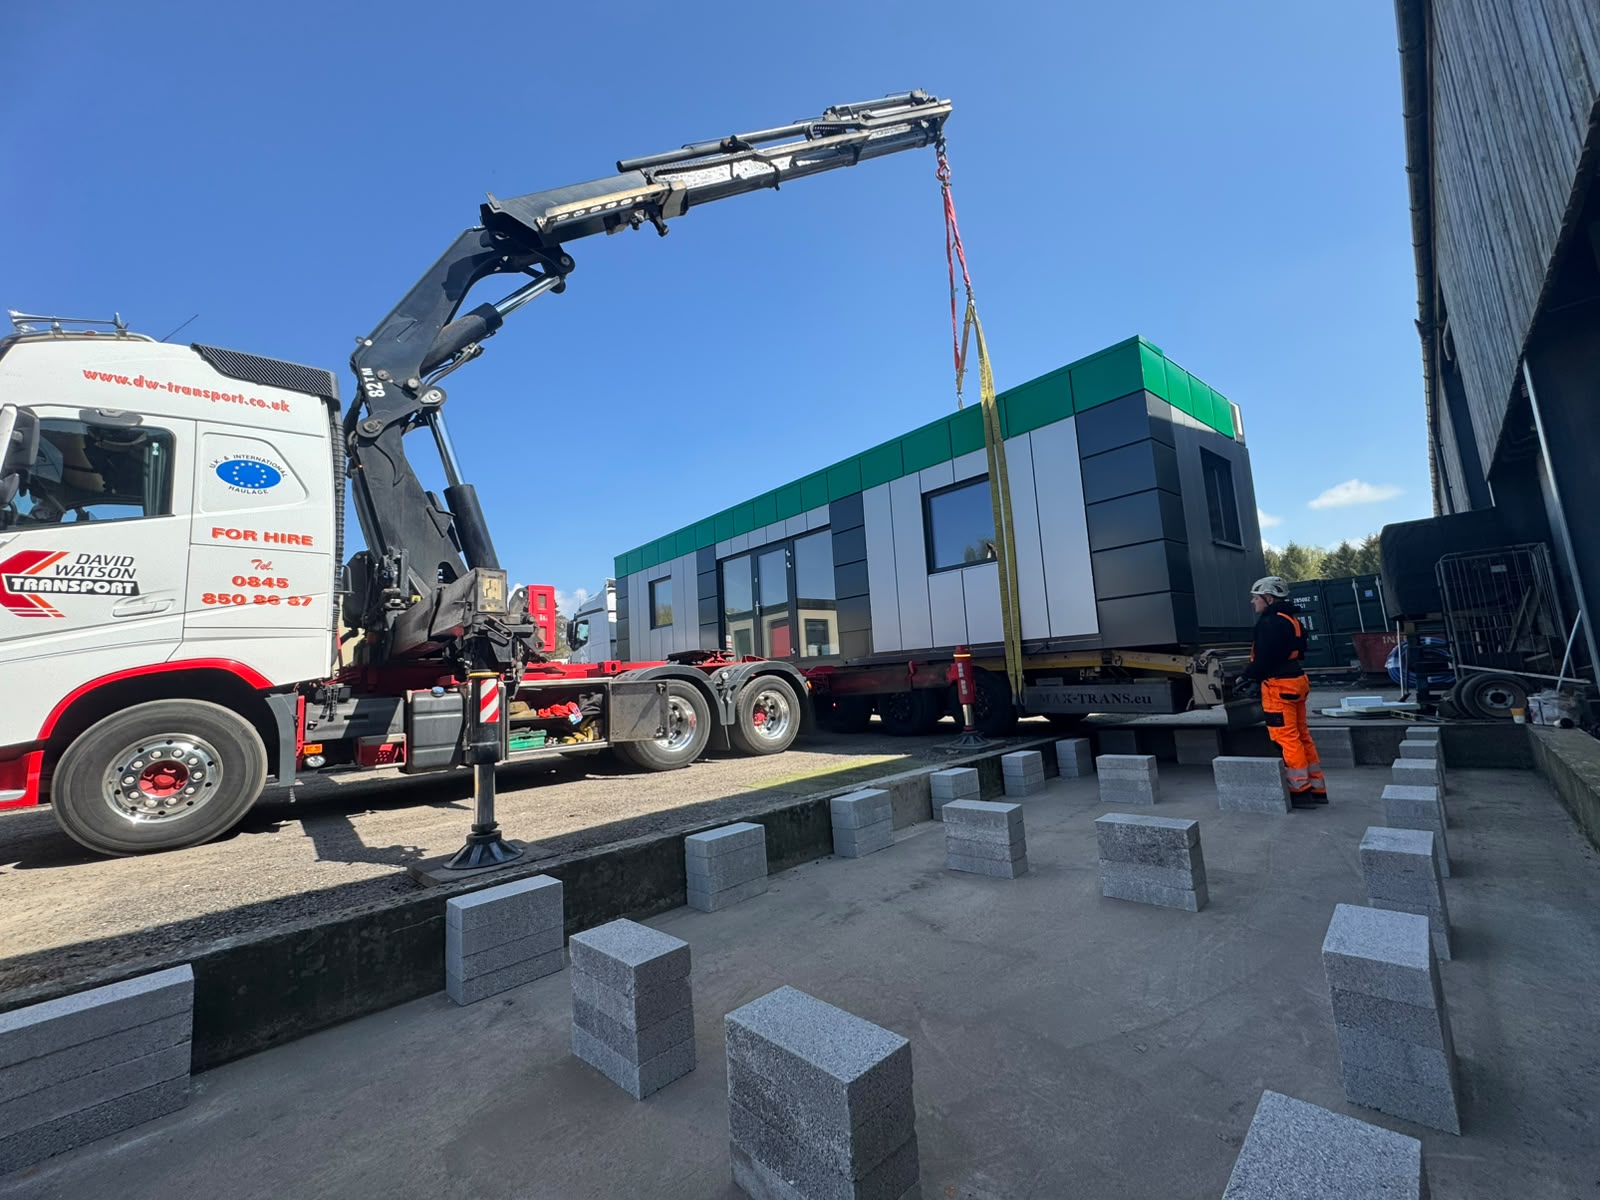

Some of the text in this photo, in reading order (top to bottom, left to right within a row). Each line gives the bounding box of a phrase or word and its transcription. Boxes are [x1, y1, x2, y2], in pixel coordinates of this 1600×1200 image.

[83, 369, 290, 412] www.dw-transport.co.uk
[232, 454, 288, 478] INTERNATIONAL
[228, 485, 269, 495] HAULAGE
[211, 527, 314, 546] FOR HIRE
[75, 553, 135, 567] DAVID
[55, 564, 136, 579] WATSON
[12, 578, 135, 594] TRANSPORT
[232, 575, 289, 588] 0845
[201, 592, 247, 606] 850
[1039, 692, 1152, 705] MAX-TRANS.eu
